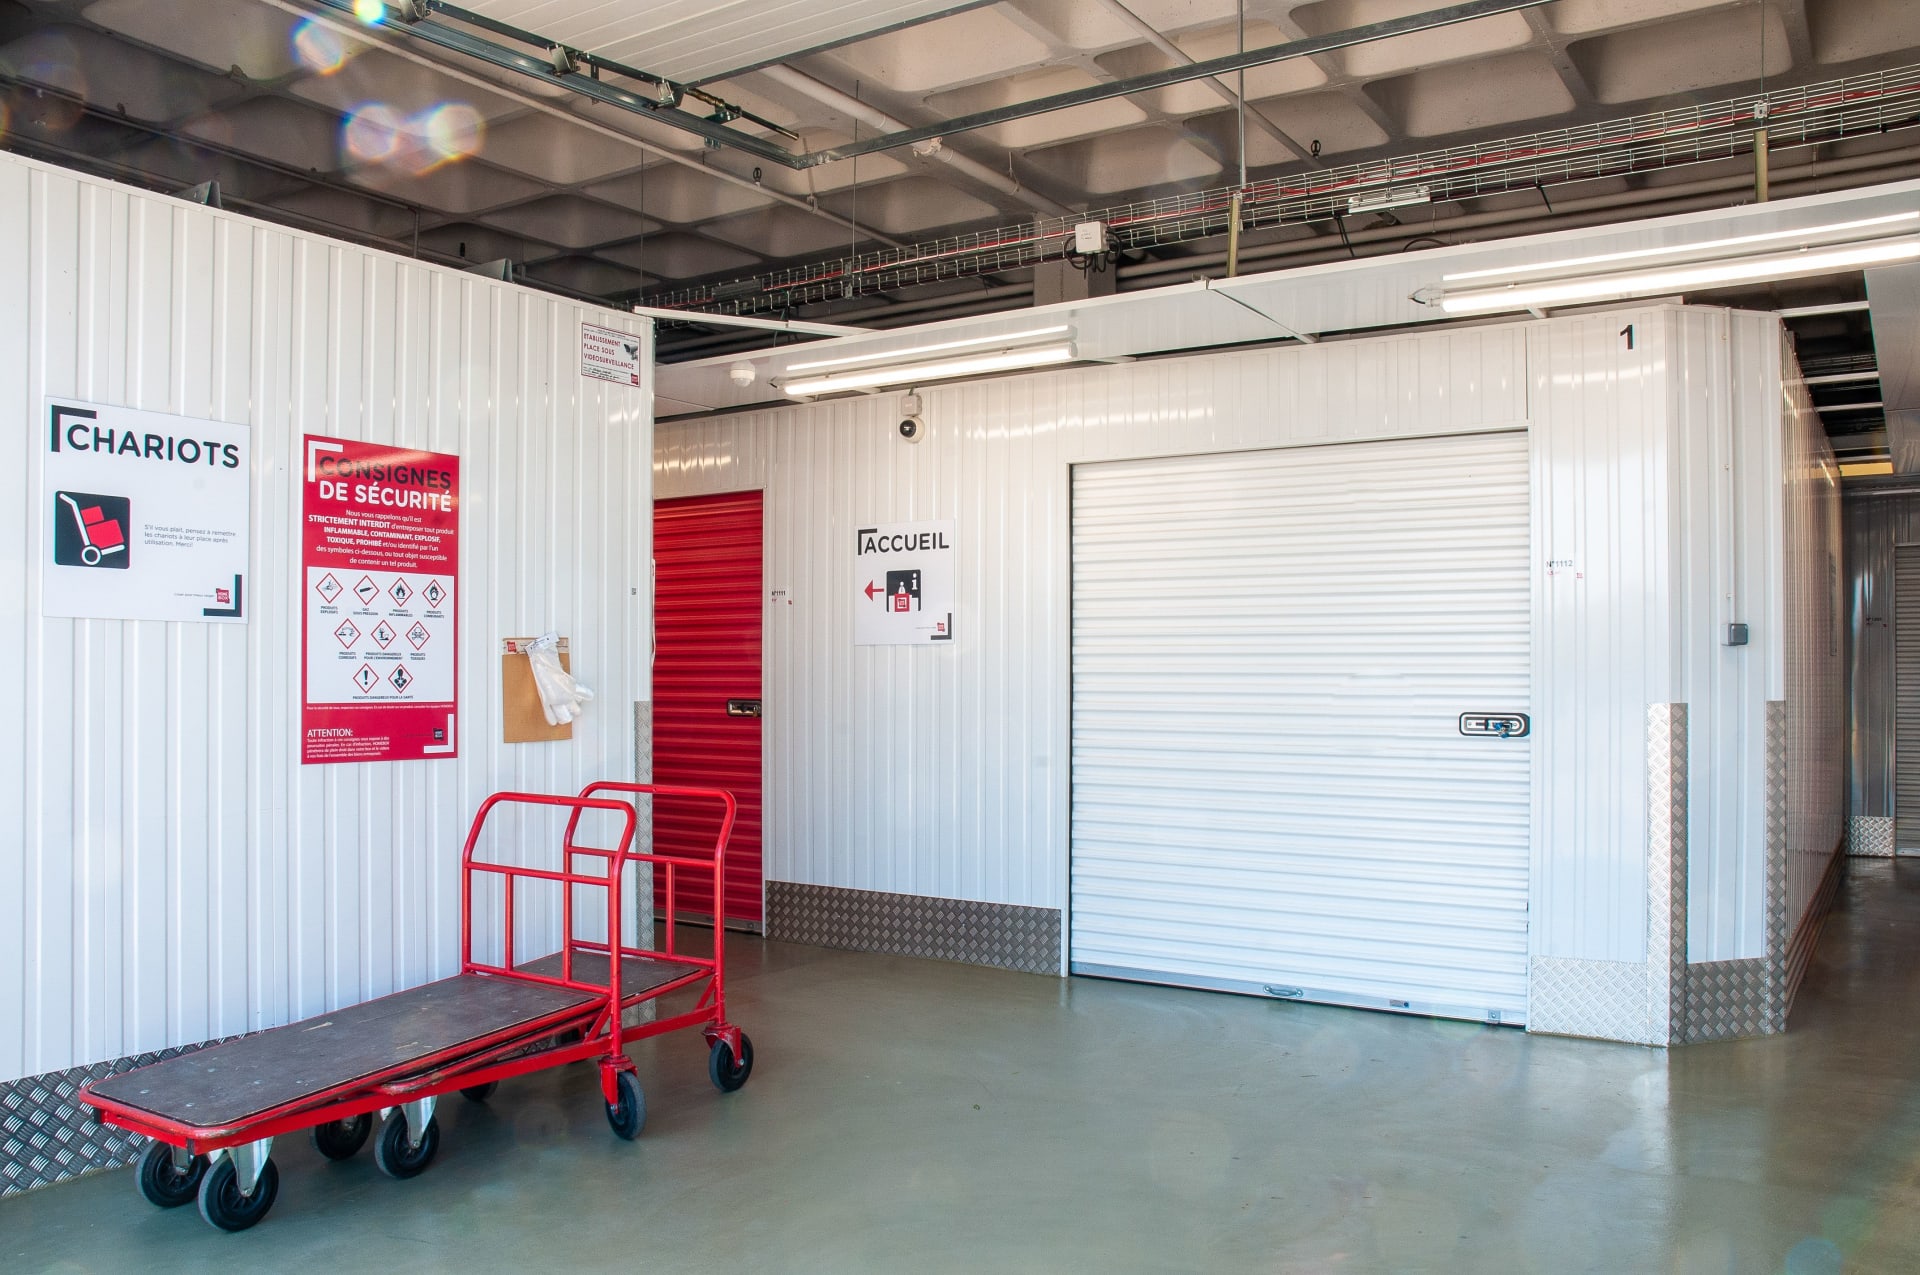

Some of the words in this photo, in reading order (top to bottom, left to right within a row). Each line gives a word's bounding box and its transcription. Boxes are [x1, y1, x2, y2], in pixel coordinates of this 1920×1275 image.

[584, 333, 621, 347] ETABLISSEMENT
[1620, 324, 1633, 350] 1
[584, 343, 600, 352] PLACE
[601, 347, 615, 356] SOUS
[584, 353, 634, 370] VIDEOSURVEILLANCE
[67, 424, 239, 468] CHARIOTS
[320, 456, 452, 490] CONSIGNES
[320, 480, 349, 502] DE
[355, 481, 452, 512] SÉCURITÉ
[308, 514, 357, 526] STRICTEMENT
[359, 520, 391, 529] INTERDIT
[346, 509, 360, 518] Nous
[361, 511, 374, 519] vous
[375, 513, 401, 521] rappelons
[864, 532, 950, 554] ACCUEIL
[307, 728, 353, 738] ATTENTION:
